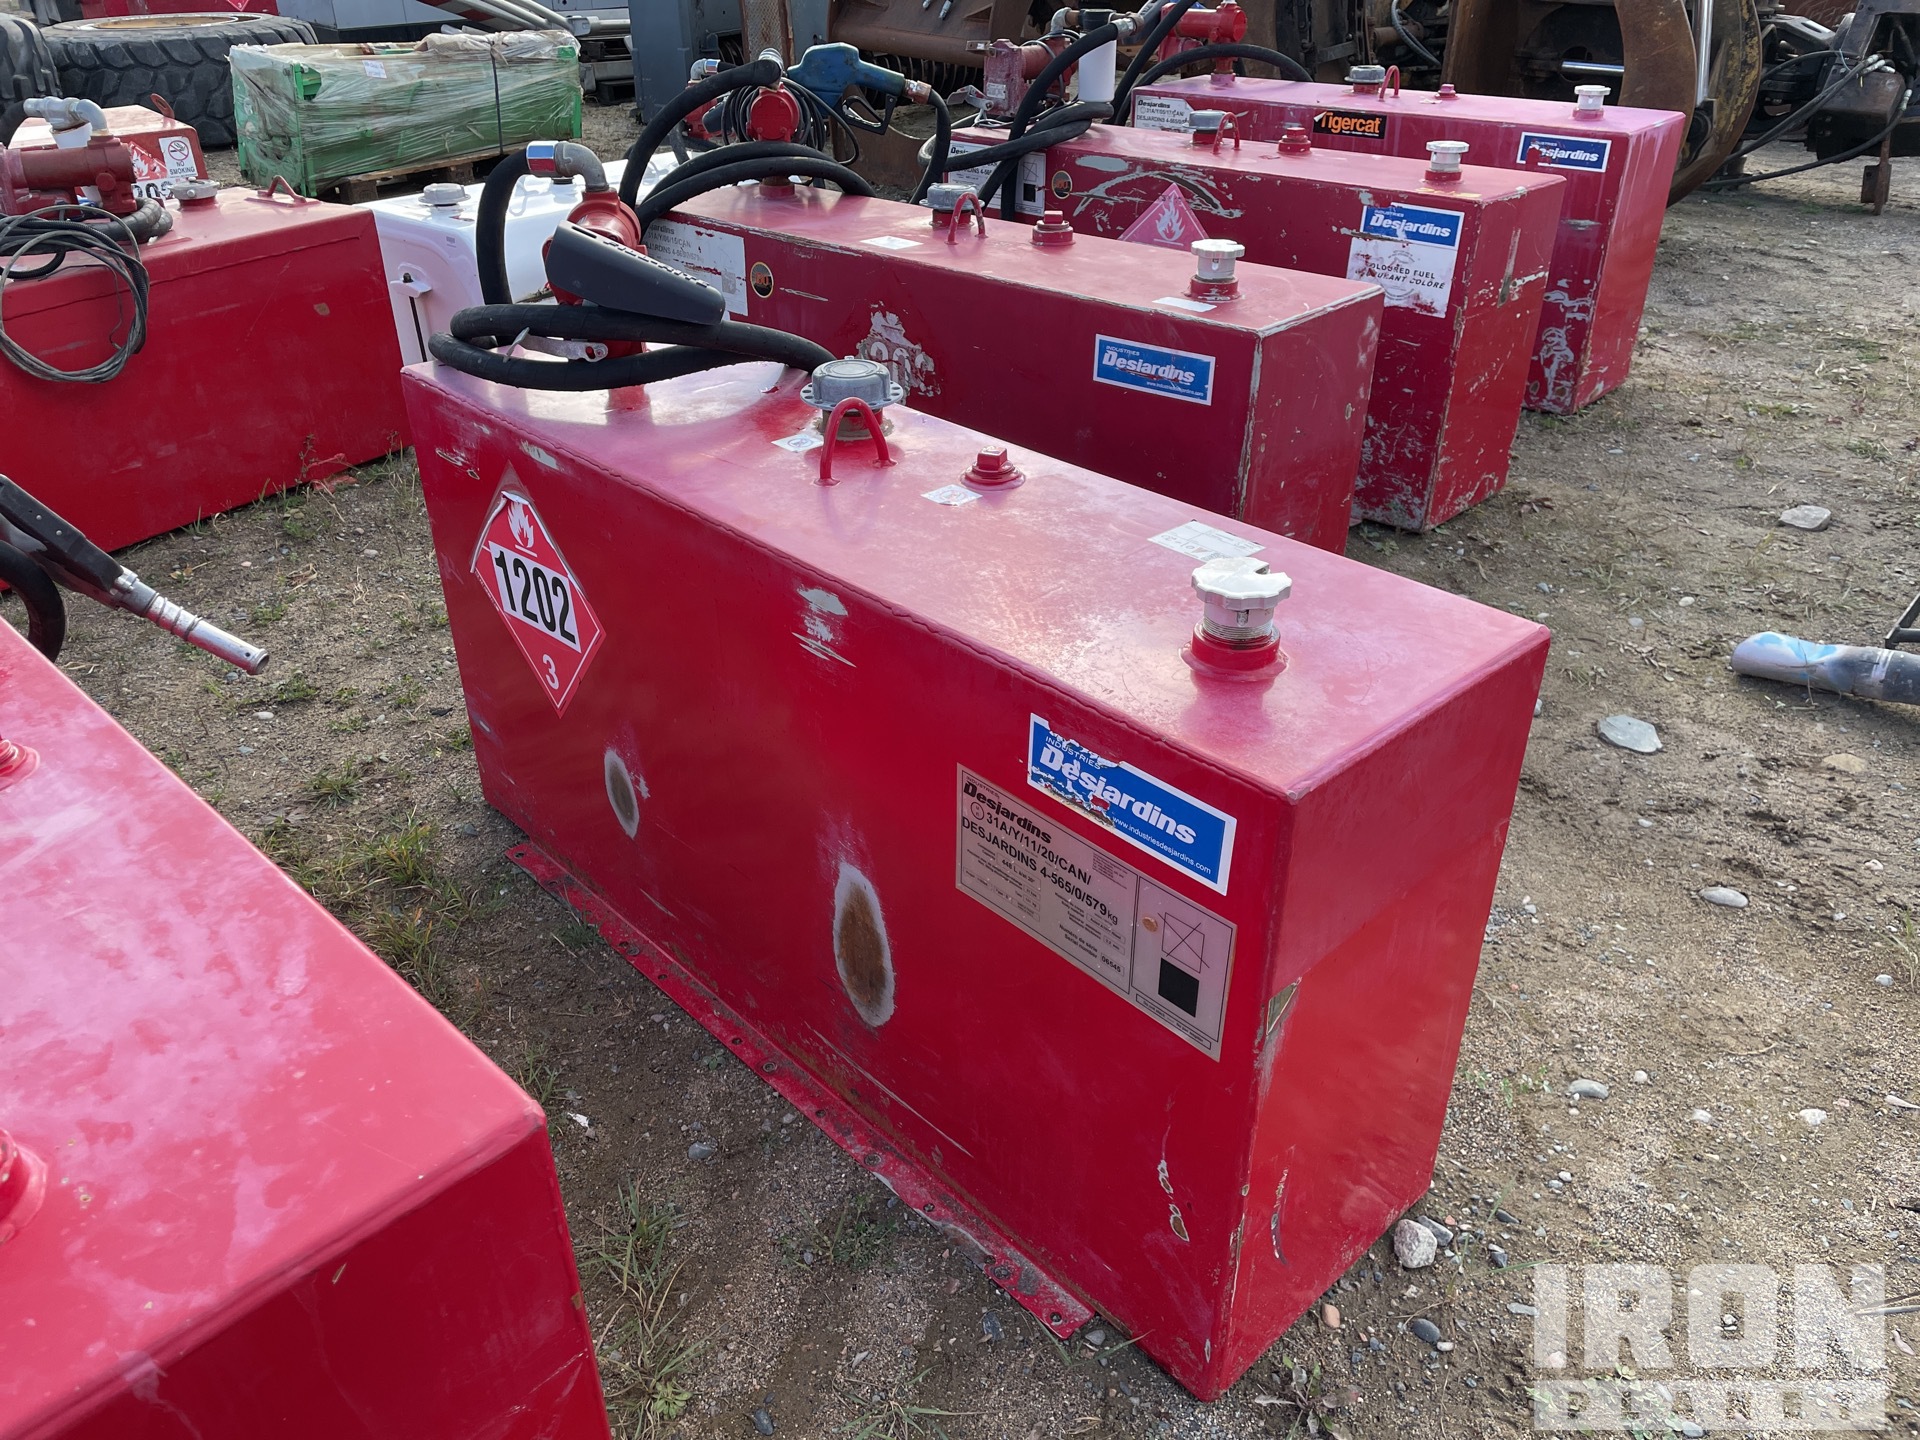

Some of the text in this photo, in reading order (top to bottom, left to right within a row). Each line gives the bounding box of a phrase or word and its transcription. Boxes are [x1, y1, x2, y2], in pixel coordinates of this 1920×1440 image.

[1138, 99, 1170, 109] Desjardins
[1321, 111, 1381, 134] Tigercat
[1528, 144, 1599, 162] esjardins
[170, 167, 196, 175] SMOKING
[1369, 213, 1452, 238] Desjardins
[1371, 262, 1436, 280] OLOURED FUEL
[1106, 345, 1140, 356] INDUSTRIES
[1102, 350, 1195, 383] Desjardins
[494, 550, 577, 644] 1202
[542, 653, 560, 690] 3
[1045, 735, 1101, 770] INDUSTRIES
[1040, 743, 1197, 845] Desjardins
[963, 778, 1051, 845] Desjardins
[962, 816, 1036, 872] DESJARDINS
[986, 811, 1091, 887] 31A/Y/11/20/CAN/
[1111, 816, 1212, 875] www.industriesdesjardins.com
[1078, 936, 1085, 945] de
[1078, 942, 1097, 959] number
